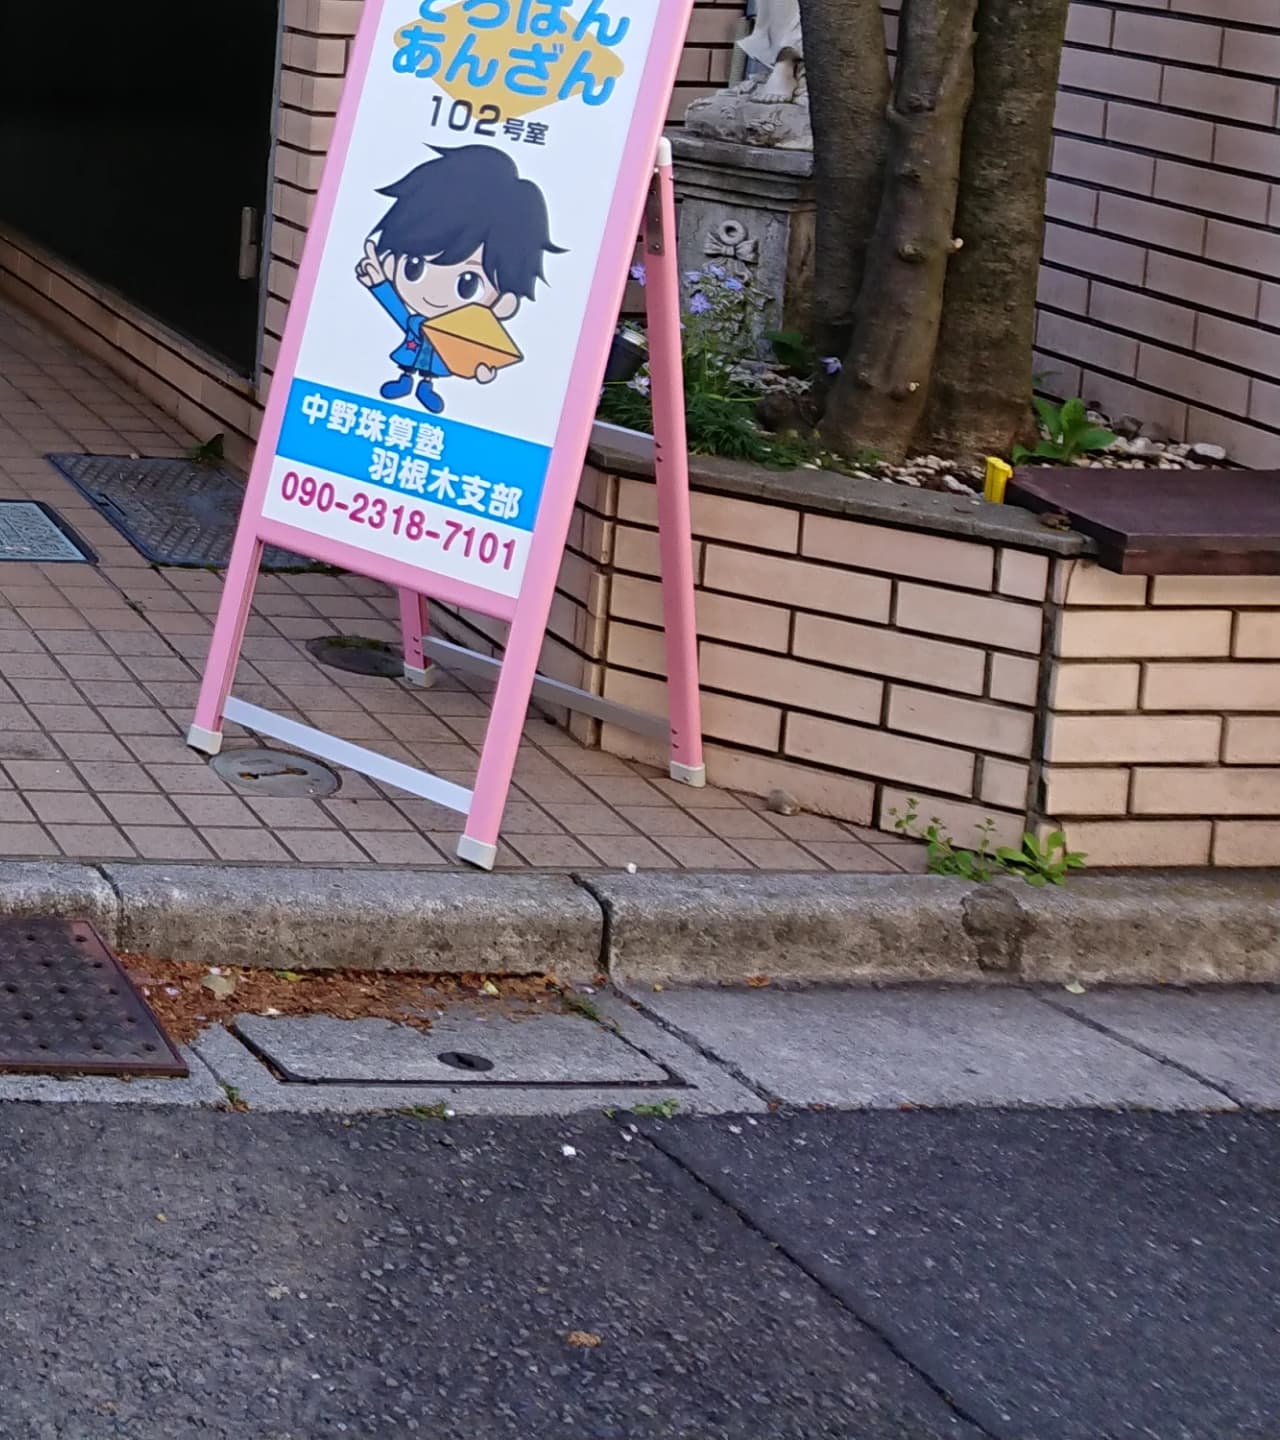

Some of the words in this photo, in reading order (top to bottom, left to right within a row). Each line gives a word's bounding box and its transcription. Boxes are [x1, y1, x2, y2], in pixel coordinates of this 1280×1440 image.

[392, 25, 616, 106] あんざん
[431, 95, 549, 146] 102号室
[302, 393, 445, 460] 中野珠算塾
[369, 447, 523, 520] 羽根木支部
[281, 472, 516, 570] 090-2318-7101
